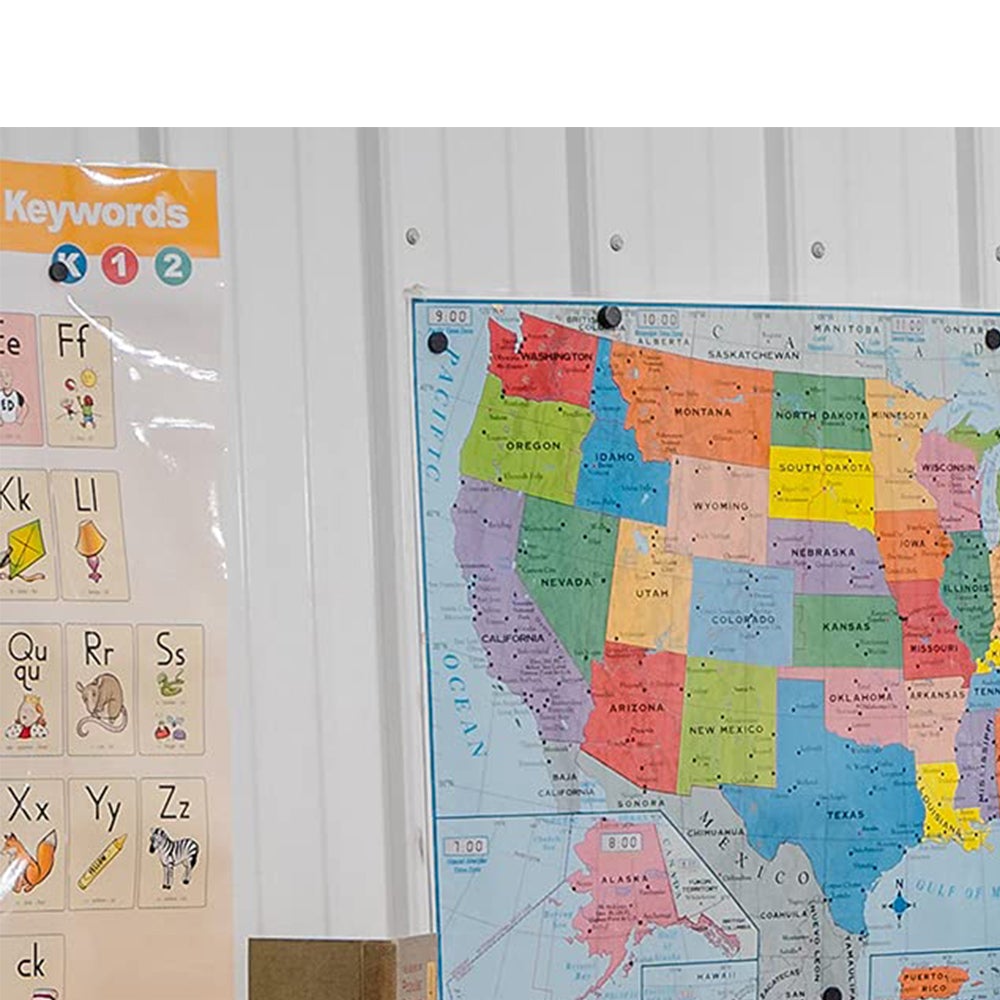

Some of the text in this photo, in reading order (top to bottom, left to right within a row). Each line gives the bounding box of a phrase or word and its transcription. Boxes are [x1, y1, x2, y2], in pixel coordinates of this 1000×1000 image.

[4, 188, 190, 234] Keywords
[111, 252, 126, 278] 1
[163, 252, 183, 278] 2
[643, 313, 678, 325] 10:00
[814, 325, 880, 334] MANITOBA
[944, 326, 984, 334] ONTAR
[58, 323, 90, 358] Ff
[638, 338, 690, 346] ALBERTA
[521, 352, 593, 361] WASHINGTON
[708, 350, 800, 361] SASKATCHEWAN
[674, 408, 732, 417] MONTANA
[776, 411, 866, 420] NORTH DAKOTA
[871, 412, 929, 420] MINNESOTA
[506, 441, 561, 450] OREGON
[595, 452, 635, 462] IDAHO
[779, 463, 871, 472] SOUTH DAKOTA
[922, 463, 976, 472] WISCONSIN
[74, 477, 98, 512] Ll
[693, 502, 749, 511] WYOMING
[900, 539, 926, 548] IOWA
[791, 549, 856, 557] NEBRASKA
[541, 578, 592, 587] NEVADA
[635, 588, 669, 598] UTAH
[943, 585, 990, 593] ILLINOIS
[711, 615, 775, 625] COLORADO
[822, 623, 871, 631] KANSAS
[481, 634, 545, 643] CALIFORNIA
[8, 631, 186, 666] Qu Rr Ss
[909, 644, 958, 653] MISSOURI
[14, 664, 41, 691] qu
[829, 693, 893, 703] OKLAHOMA
[910, 691, 965, 700] ARKANSAS
[609, 703, 664, 713] ARIZONA
[689, 725, 764, 734] NEW MEXICO
[552, 773, 578, 781] BAJA
[537, 788, 595, 797] CALIFORNIA
[7, 785, 190, 832] Xx Yy Zz
[618, 800, 665, 808] SONORA
[827, 811, 865, 820] TEXAS
[920, 786, 964, 839] LOUISIANA
[686, 828, 745, 837] CHIHUAHUA
[608, 836, 638, 849] 8:00
[601, 875, 649, 883] ALASKA
[896, 878, 904, 891] N
[16, 942, 46, 978] ck
[697, 971, 736, 981] HAWAII
[903, 972, 944, 981] PUERTO
[921, 984, 947, 993] RICO
